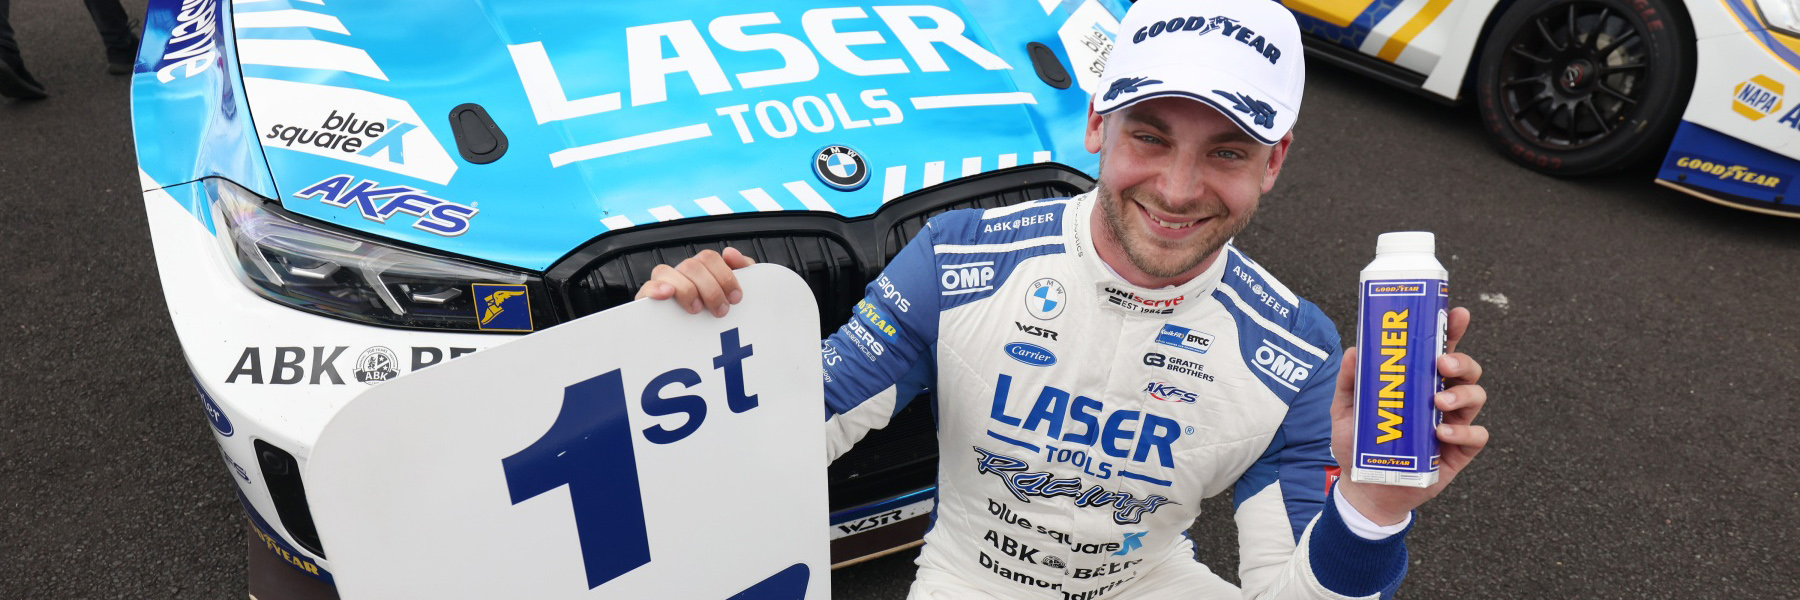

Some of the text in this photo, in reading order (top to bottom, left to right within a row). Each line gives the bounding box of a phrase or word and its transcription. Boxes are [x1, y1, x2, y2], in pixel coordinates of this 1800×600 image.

[1080, 31, 1107, 53] blue
[1132, 16, 1281, 65] GOODYEAR
[507, 5, 1013, 124] LASER
[1738, 83, 1777, 113] NAPA
[321, 110, 385, 138] blue
[715, 88, 904, 144] TOOLS
[266, 124, 362, 153] square
[819, 146, 857, 162] BMW
[1676, 156, 1780, 188] GOODYEAR
[294, 174, 478, 237] AKFS
[984, 212, 1054, 233] ABK BEER
[942, 266, 995, 290] OMP
[1034, 280, 1064, 295] BMW
[1233, 265, 1290, 318] ABK BEER
[1375, 284, 1419, 293] GOODYEAR
[1121, 301, 1139, 311] EST
[1015, 321, 1059, 342] WSR
[1186, 335, 1210, 347] BTCC
[224, 346, 350, 385] ABK
[1011, 345, 1051, 363] Carrier
[1169, 357, 1204, 371] GRATTE
[1256, 346, 1309, 384] OMP
[365, 371, 388, 380] ABK
[1167, 364, 1215, 382] BROTHERS
[1376, 308, 1410, 445] WINNER
[1142, 382, 1199, 404] AKFS
[990, 373, 1181, 469] LASER
[501, 327, 759, 591] 1st
[1046, 445, 1112, 480] TOOLS
[1367, 458, 1411, 466] GOODYEAR
[973, 446, 1181, 525] Racing
[838, 510, 902, 534] WSR
[988, 498, 1032, 530] blue
[983, 530, 1041, 565] ABK
